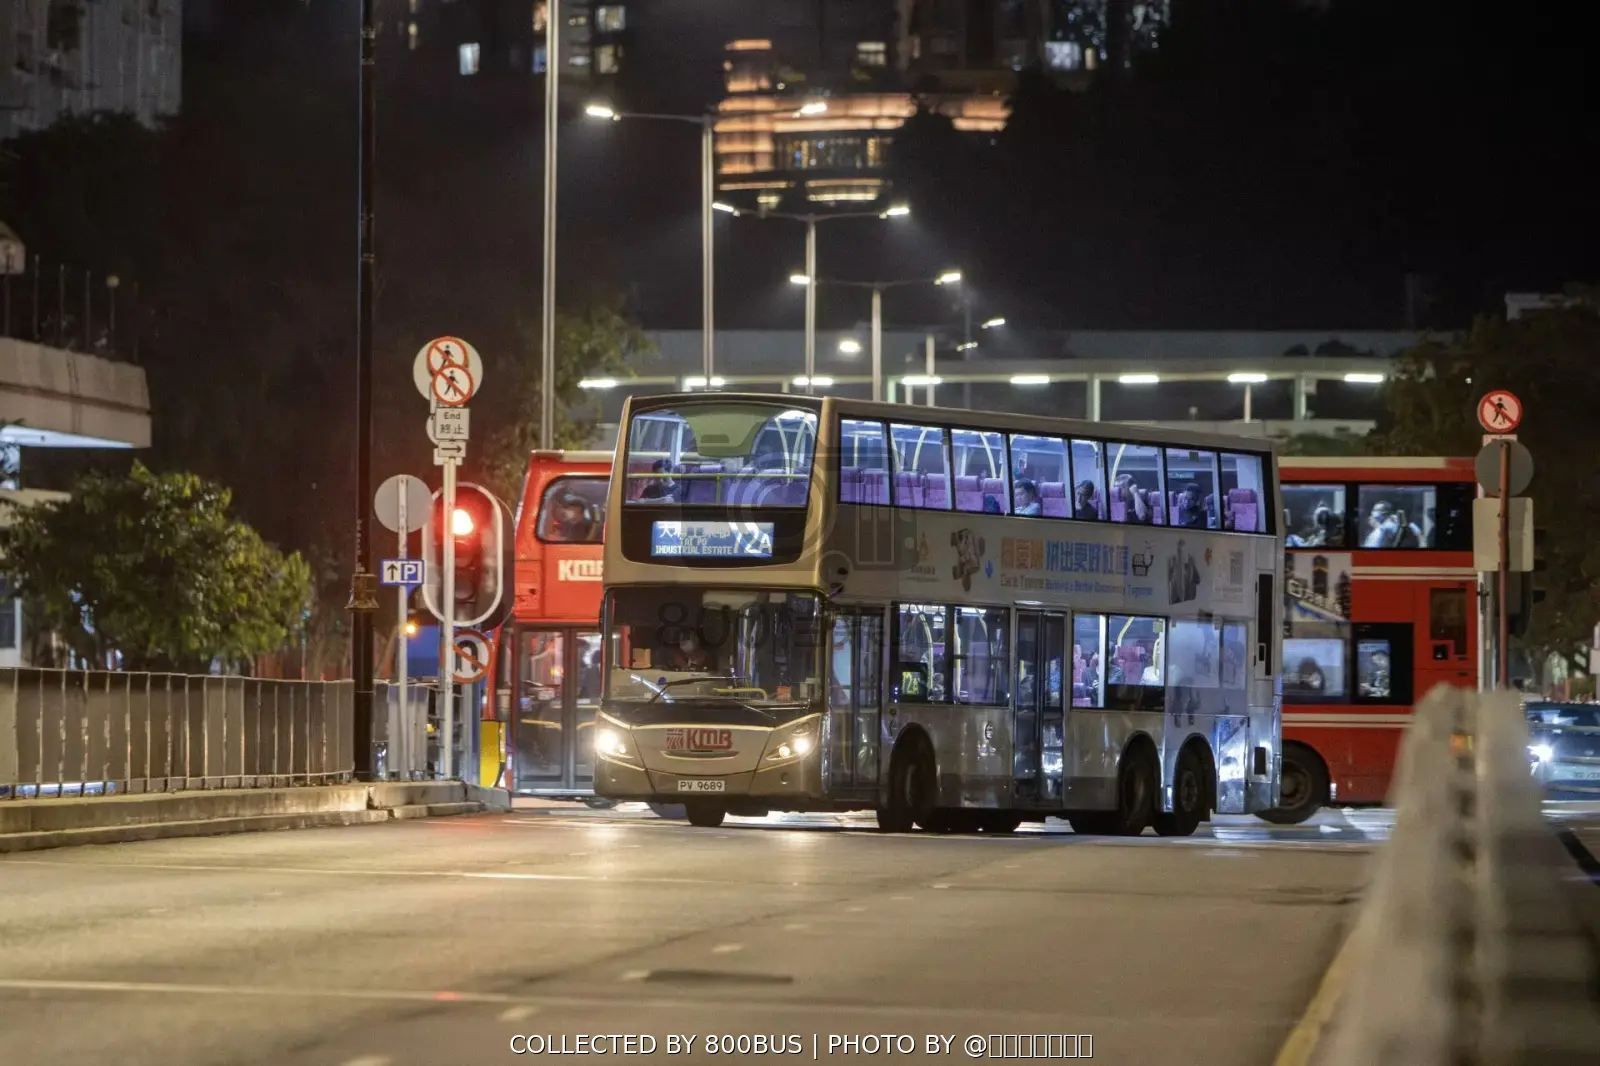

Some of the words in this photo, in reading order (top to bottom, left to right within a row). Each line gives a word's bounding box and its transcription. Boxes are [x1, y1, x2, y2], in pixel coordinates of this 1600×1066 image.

[444, 411, 461, 420] End
[440, 423, 465, 435] 終止
[680, 538, 695, 546] TAI
[697, 538, 707, 546] PO
[655, 545, 701, 554] INDUSTRIAL
[702, 545, 733, 555] ESTATE
[403, 564, 417, 580] P
[687, 728, 733, 750] KMB
[680, 781, 693, 791] PV
[697, 781, 723, 791] 9689
